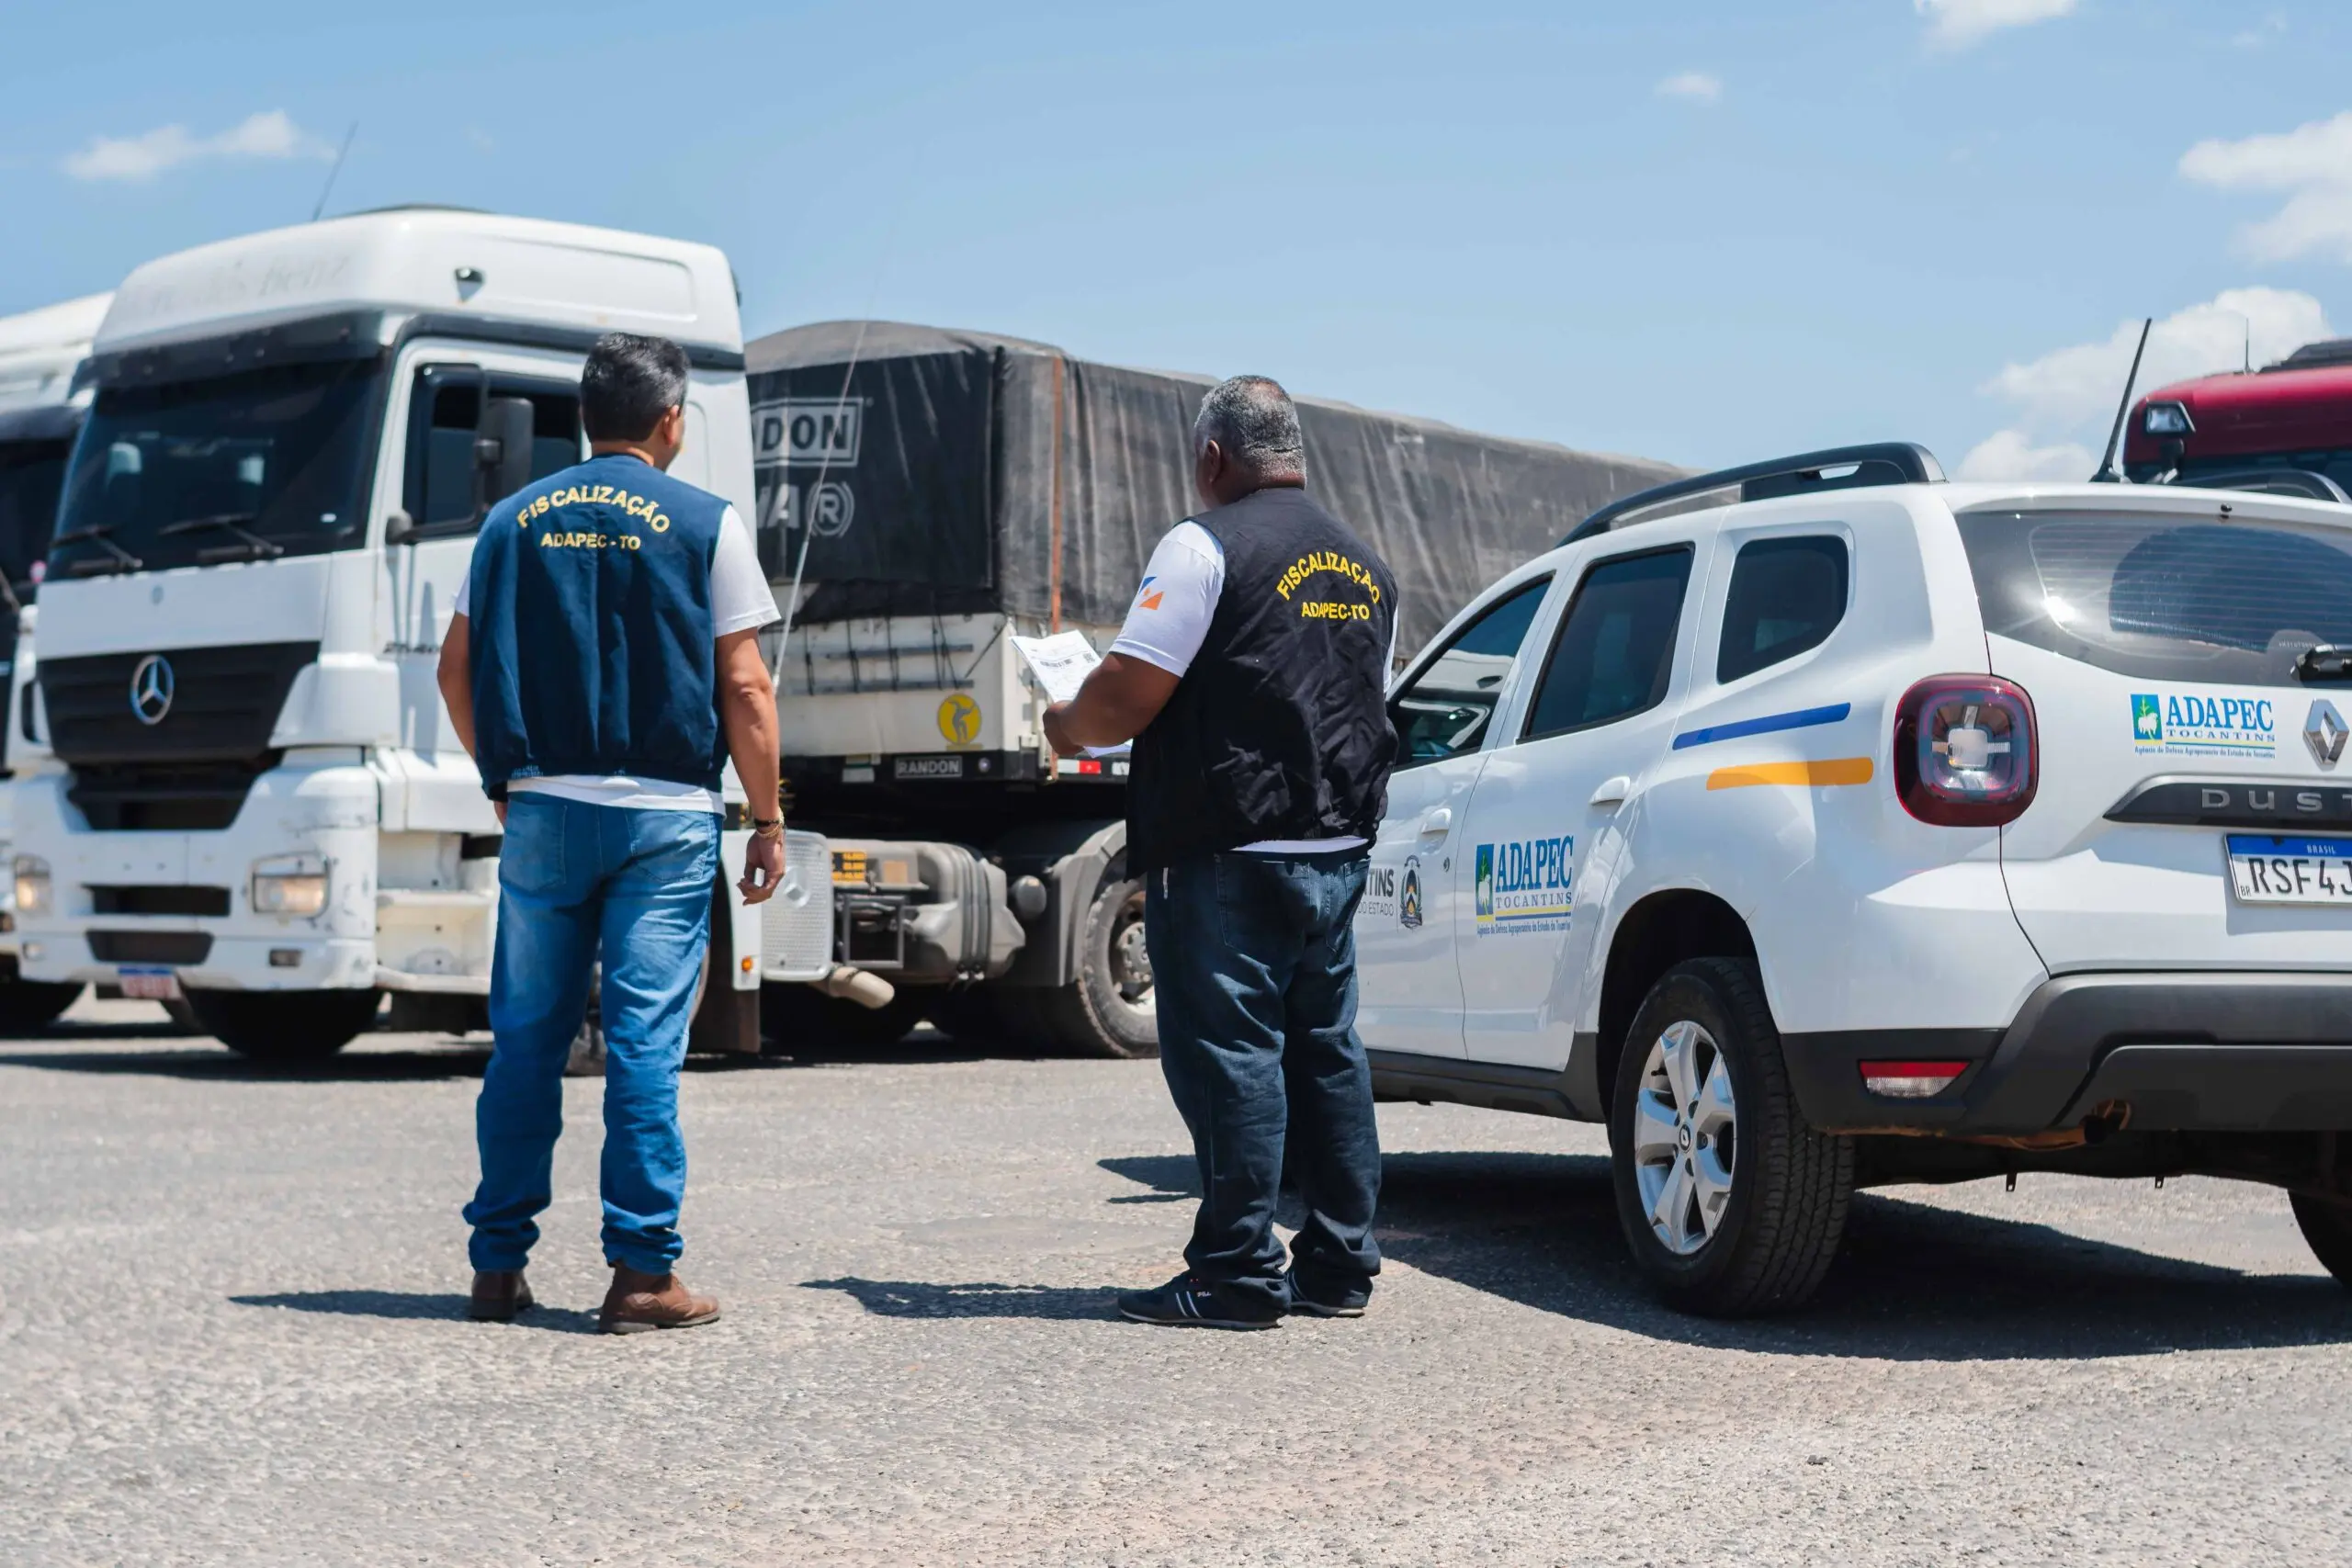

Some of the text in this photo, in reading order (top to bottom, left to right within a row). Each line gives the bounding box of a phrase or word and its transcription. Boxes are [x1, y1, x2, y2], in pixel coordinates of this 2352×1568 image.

[753, 415, 849, 452] DON
[516, 485, 671, 534] FISCALIZAÇÃO
[2165, 695, 2275, 732] ADAPEC
[2166, 729, 2276, 742] TOCANTINS
[898, 760, 959, 775] RANDON
[2306, 844, 2336, 854] BRASIL
[1495, 835, 1574, 893] ADAPEC
[1364, 867, 1395, 897] TINS
[1368, 901, 1395, 917] ESTADO
[1495, 891, 1572, 909] TOCANTINS
